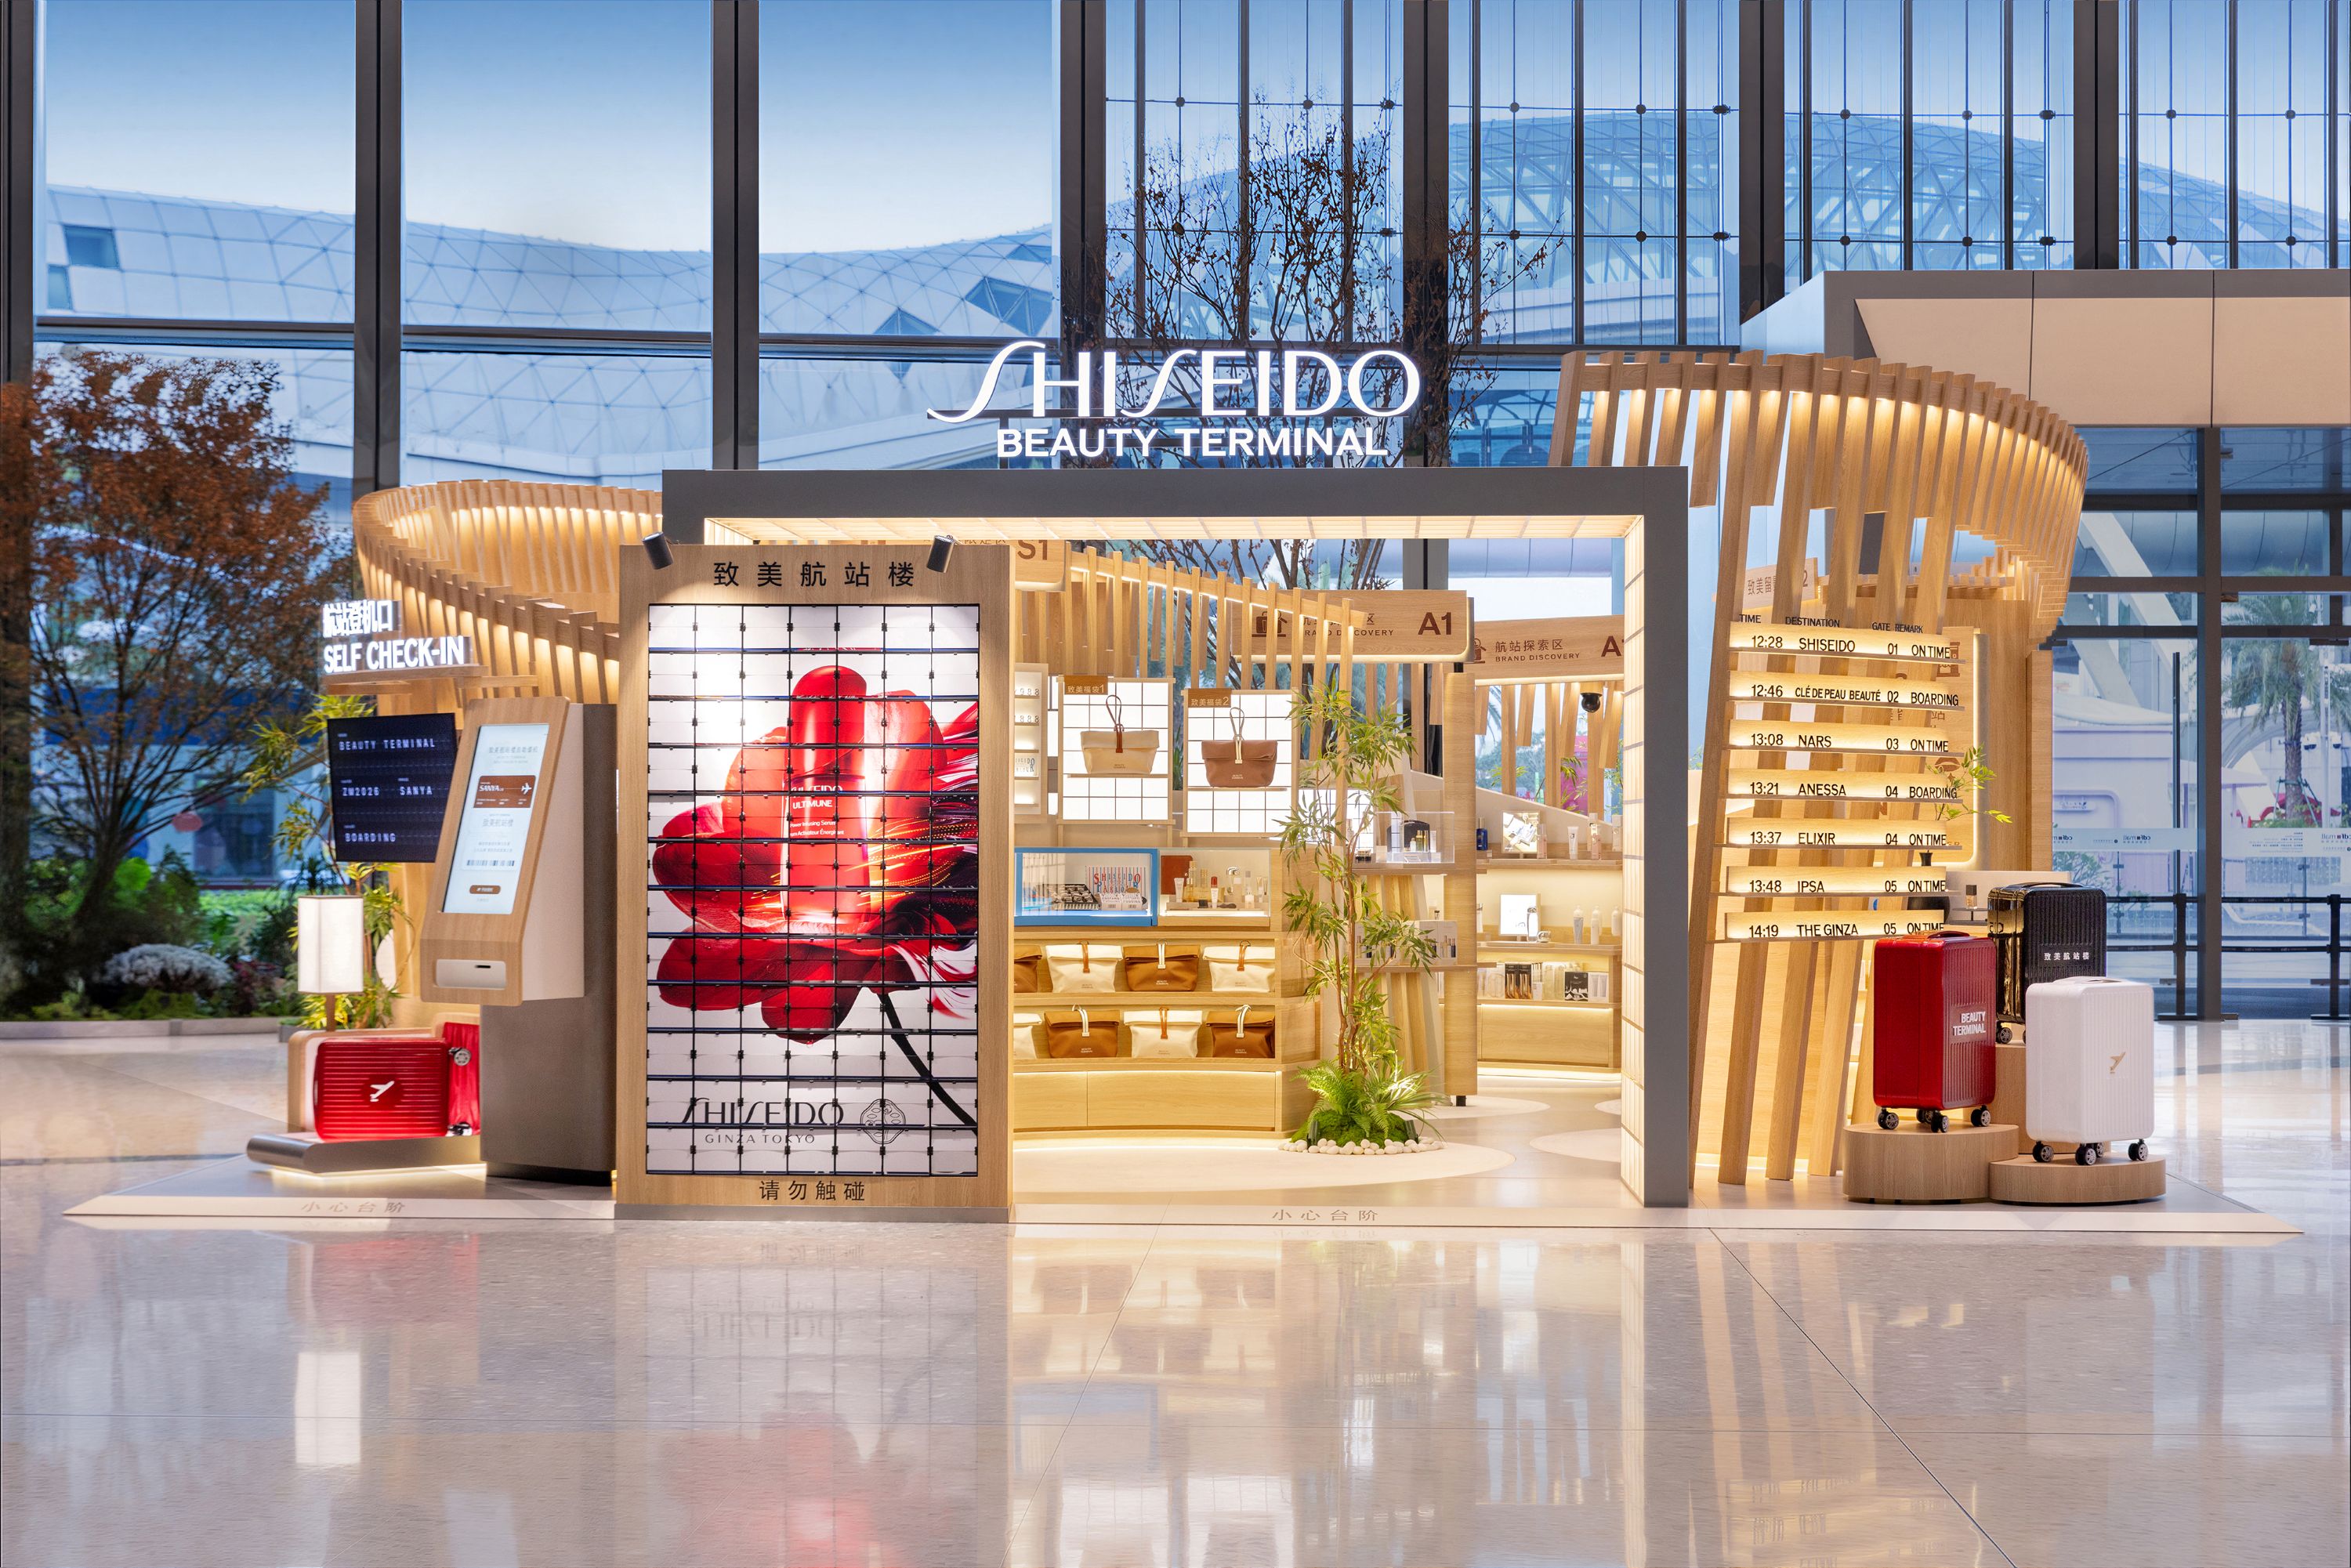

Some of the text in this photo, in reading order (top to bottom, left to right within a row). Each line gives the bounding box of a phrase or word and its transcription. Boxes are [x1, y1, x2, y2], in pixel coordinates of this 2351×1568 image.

[927, 341, 1420, 423] SHISEIDO
[996, 428, 1388, 458] BEAUTY TERMINAL
[1017, 540, 1048, 560] S1
[713, 561, 915, 588] 致美航站楼
[1418, 611, 1452, 636] A1
[1739, 614, 1923, 633] TIME DESTINATION GATE REMARK
[1495, 639, 1563, 653] 航站探索区
[1601, 636, 1625, 657] A
[1751, 636, 1951, 658] 12:28 SHISEIDO 01 ON TIME
[324, 636, 465, 673] SELF CHECK-IN
[1190, 697, 1230, 706] 致美福袋2
[1751, 684, 1958, 706] 12:46 CLÉ DE PEAU BEAUTÉ 02 BOARDING
[339, 738, 436, 751] BEAUTY TERMINAL
[1751, 733, 1949, 751] 13:08 NARS 03 ON TIME
[400, 785, 433, 796] SANYA
[1750, 781, 1958, 798] 13:21 ANESSA 04 BOARDING
[792, 799, 833, 809] ULTIMUNE
[345, 832, 397, 842] BOARDING
[1750, 831, 1947, 846] 13:37 ELIXIR 04 ON TIME
[1749, 880, 1946, 893] 13:48 IPSA 05 ON TIME
[1749, 925, 1779, 938] 14:19
[1796, 924, 1821, 936] THE
[1824, 924, 1859, 936] GINZA
[1884, 922, 1896, 935] 05
[1961, 1011, 1987, 1023] BEAUTY
[1952, 1023, 1987, 1036] TERMINAL
[680, 1097, 844, 1125] SHISEDO
[705, 1134, 815, 1144] GINZA TOKYO
[759, 1180, 865, 1201] 请勿触碰
[301, 1200, 406, 1214] 小心台阶
[1272, 1209, 1379, 1222] 小心台阶
